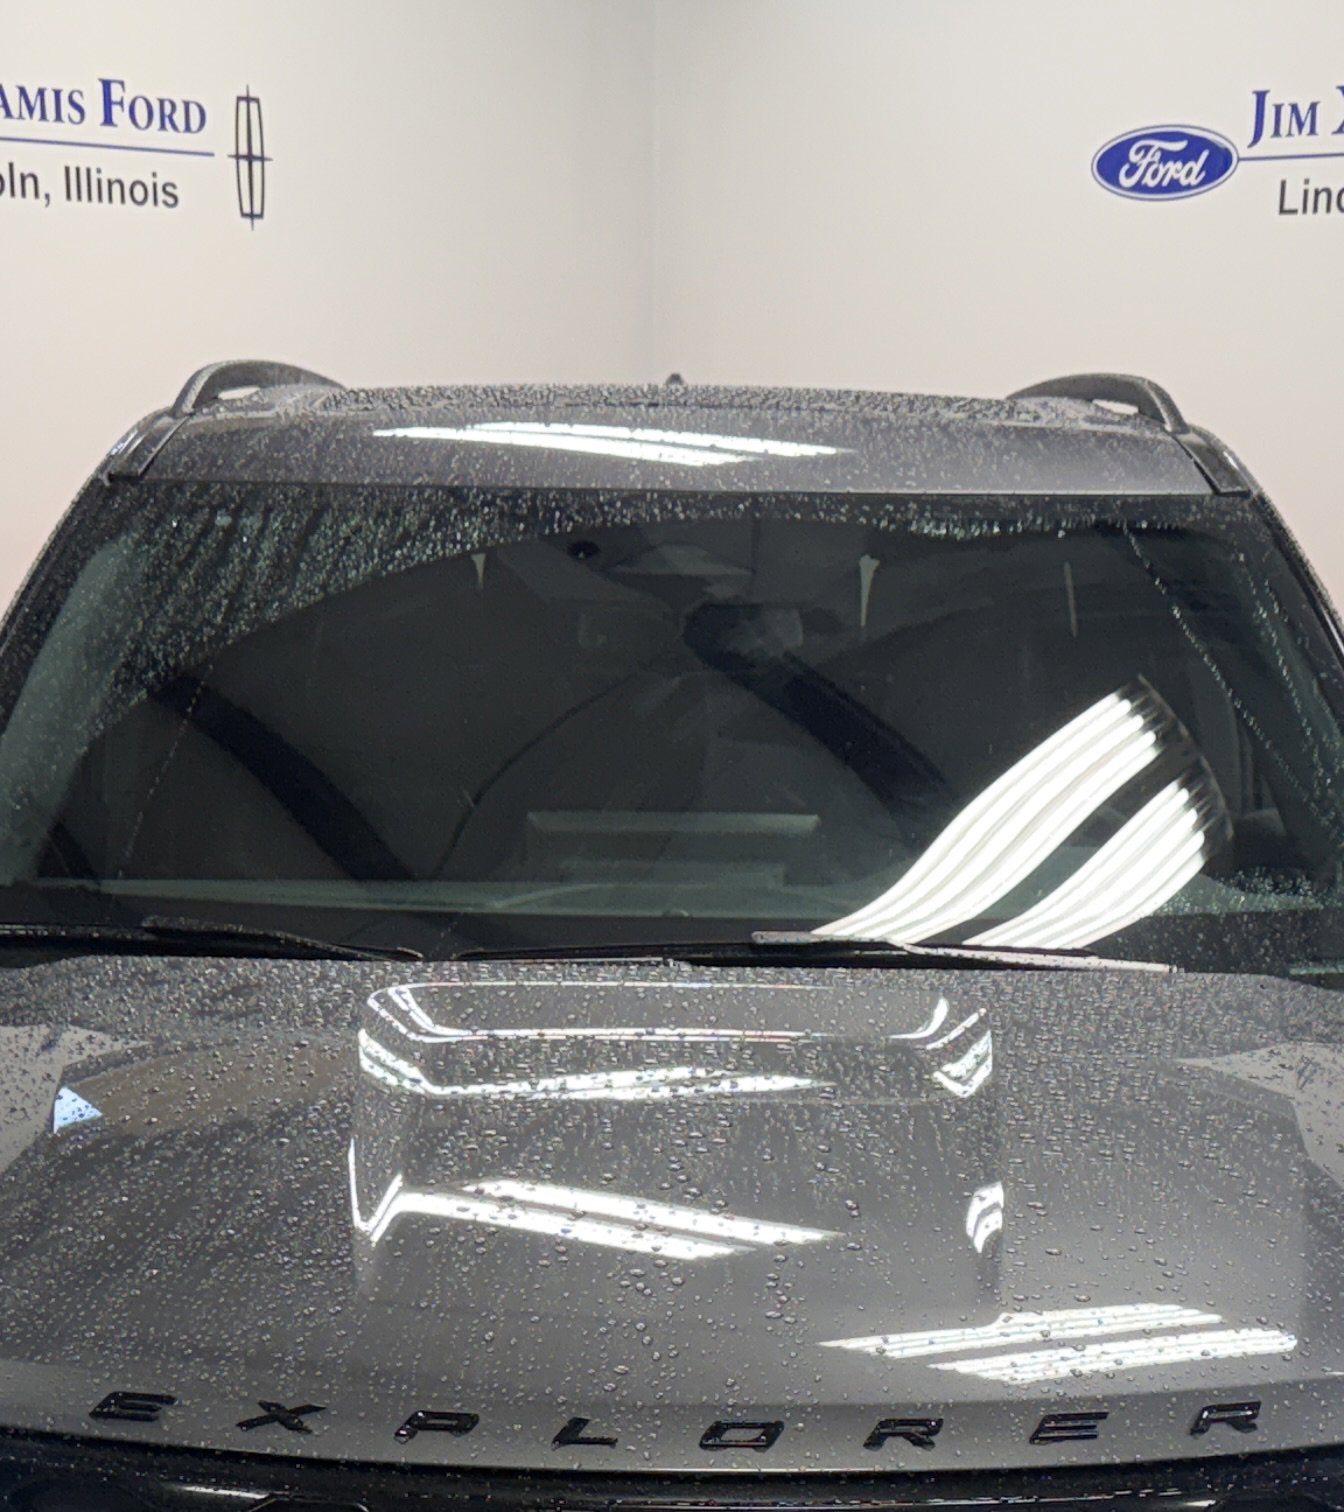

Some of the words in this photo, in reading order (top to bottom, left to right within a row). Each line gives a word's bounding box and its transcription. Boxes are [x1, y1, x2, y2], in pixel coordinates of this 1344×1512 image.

[64, 165, 180, 209] Illinois
[1118, 139, 1206, 189] Ford
[88, 1390, 1262, 1452] EXPLORER
